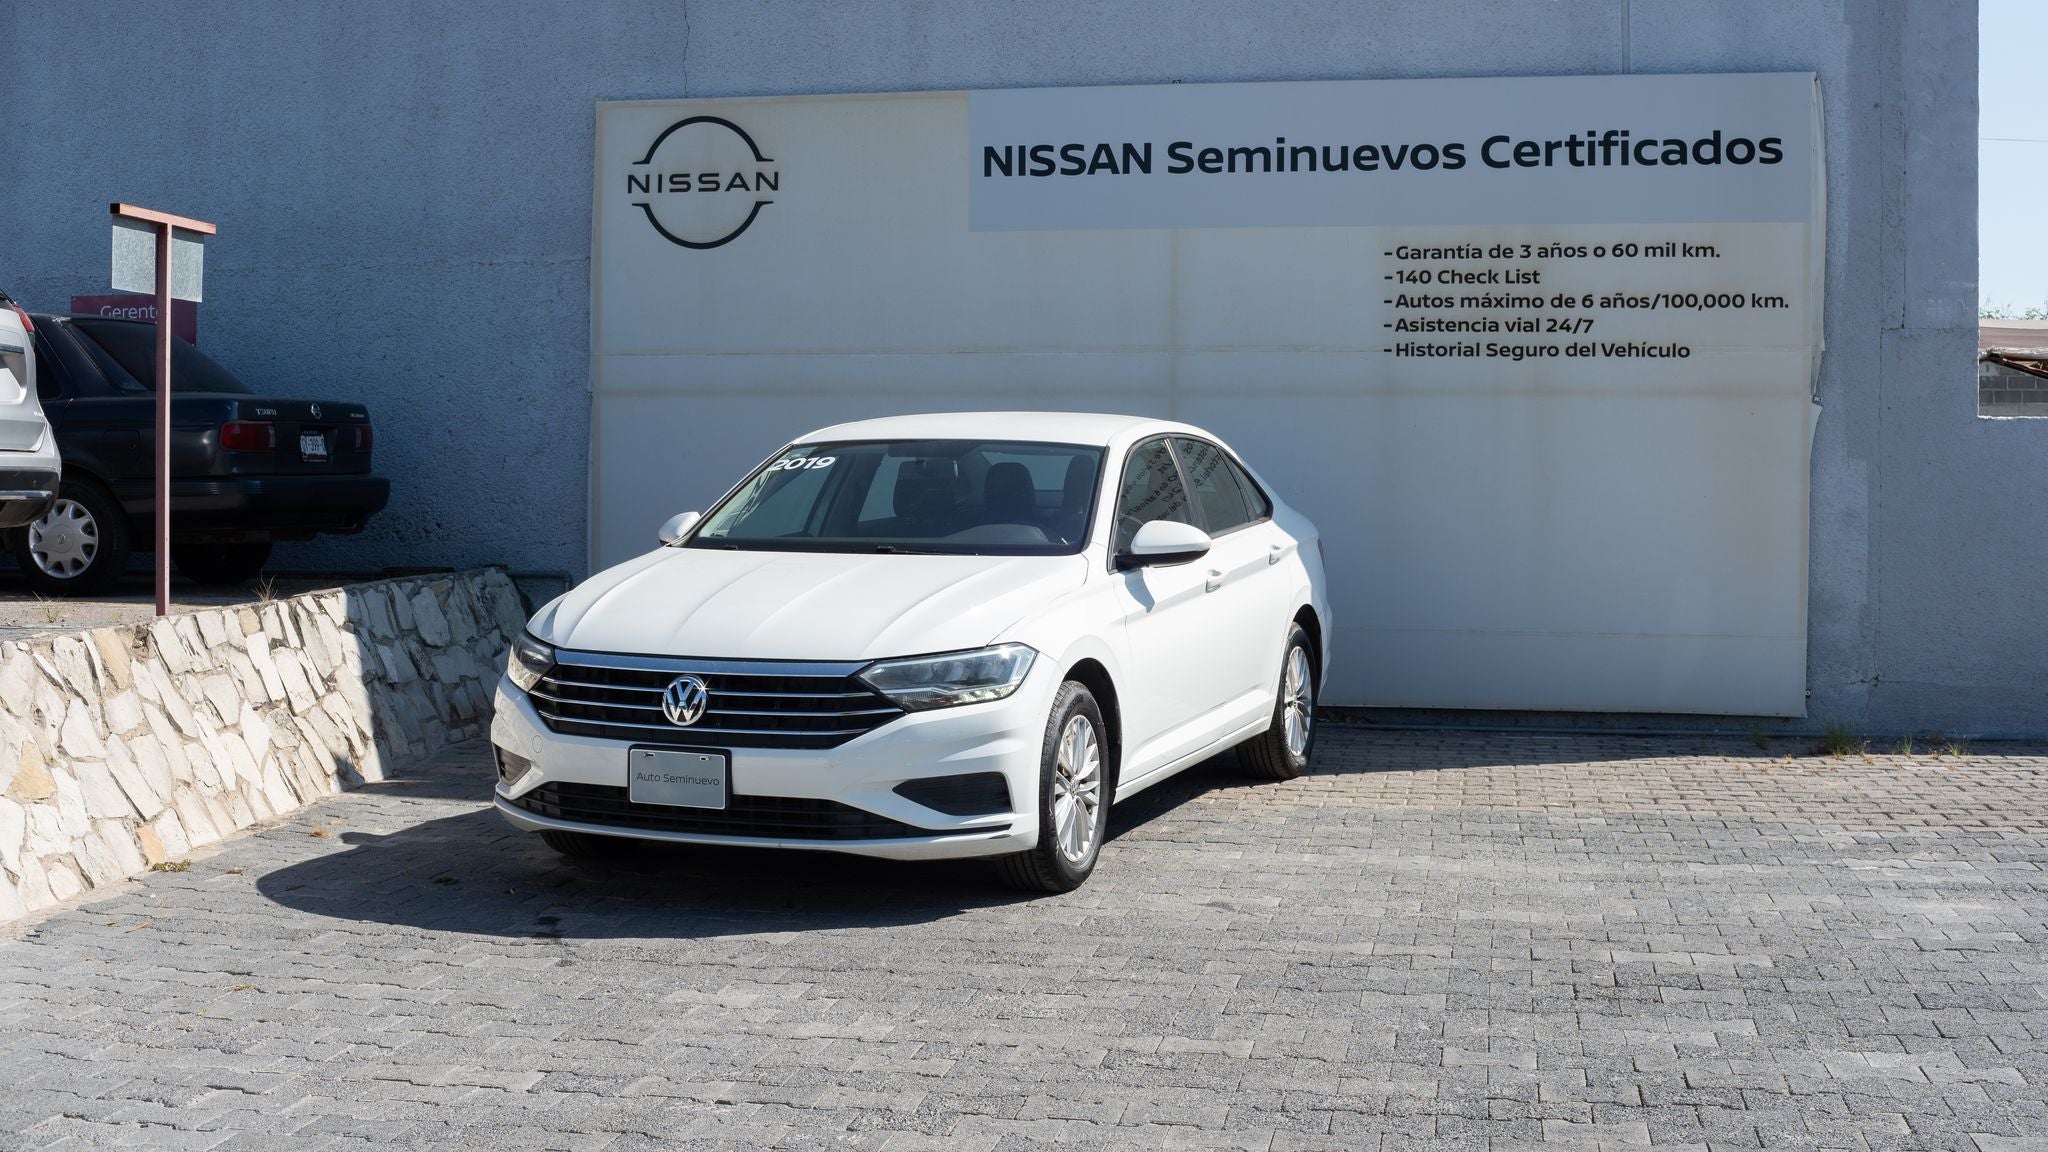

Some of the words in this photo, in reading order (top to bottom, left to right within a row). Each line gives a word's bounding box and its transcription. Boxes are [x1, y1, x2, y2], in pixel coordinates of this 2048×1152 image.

[984, 142, 1151, 178] NISSAN
[1167, 136, 1467, 175] Seminuevos
[1480, 129, 1784, 169] Certificados
[627, 171, 779, 194] NISSAN
[1488, 243, 1514, 259] de
[1519, 244, 1532, 259] 3
[1537, 242, 1588, 259] años
[1592, 245, 1607, 258] o
[1611, 242, 1639, 258] 60
[1644, 241, 1676, 258] mil
[1682, 242, 1721, 258] km.
[1437, 268, 1500, 285] Check
[1505, 268, 1541, 285] List
[1460, 292, 1545, 309] máximo
[1550, 293, 1576, 309] de
[1581, 293, 1594, 309] 6
[1599, 292, 1746, 312] años/100,000
[1751, 292, 1789, 309] km.
[100, 304, 159, 320] Gerent
[1504, 316, 1540, 333] vial
[1545, 317, 1594, 335] 24/7
[1486, 342, 1560, 362] Seguro
[1564, 341, 1597, 358] del
[1600, 341, 1691, 359] Vehículo
[768, 456, 837, 471] 2019
[636, 771, 661, 783] Auto
[663, 773, 720, 786] Seminuevo
